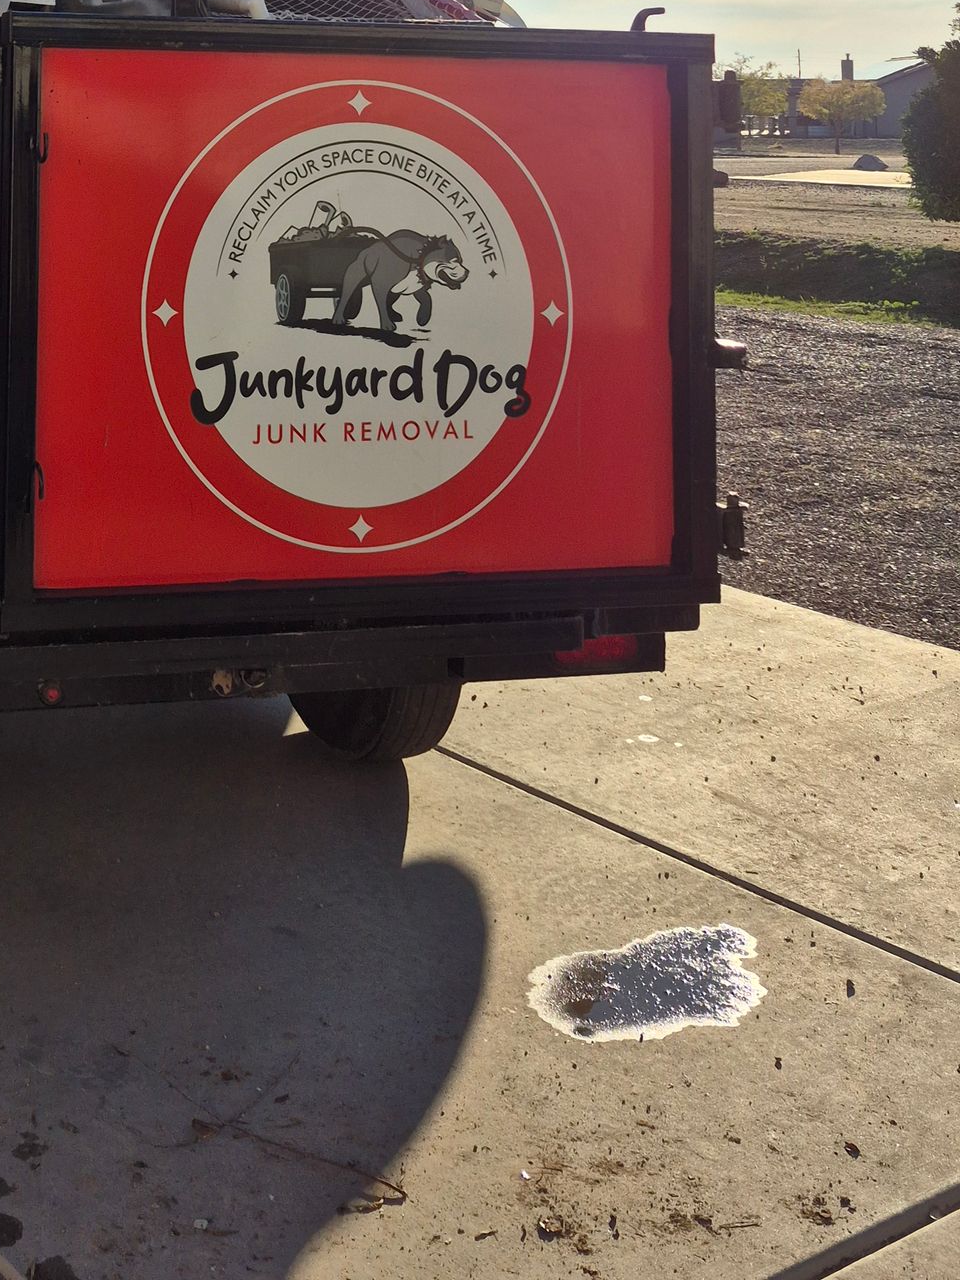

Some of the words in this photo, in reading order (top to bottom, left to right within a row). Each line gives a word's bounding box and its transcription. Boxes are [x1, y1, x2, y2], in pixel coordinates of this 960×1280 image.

[228, 189, 278, 263] RECLAIM
[274, 159, 320, 192] YOUR
[321, 149, 374, 169] SPACE
[378, 150, 416, 174] ONE
[416, 163, 451, 194] BITE
[447, 191, 468, 209] AT
[462, 211, 476, 224] A
[472, 222, 497, 264] TIME
[190, 348, 424, 426] Junkyard
[432, 348, 531, 418] Dog
[252, 422, 328, 445] JUNK
[343, 419, 475, 443] REMOVAL
